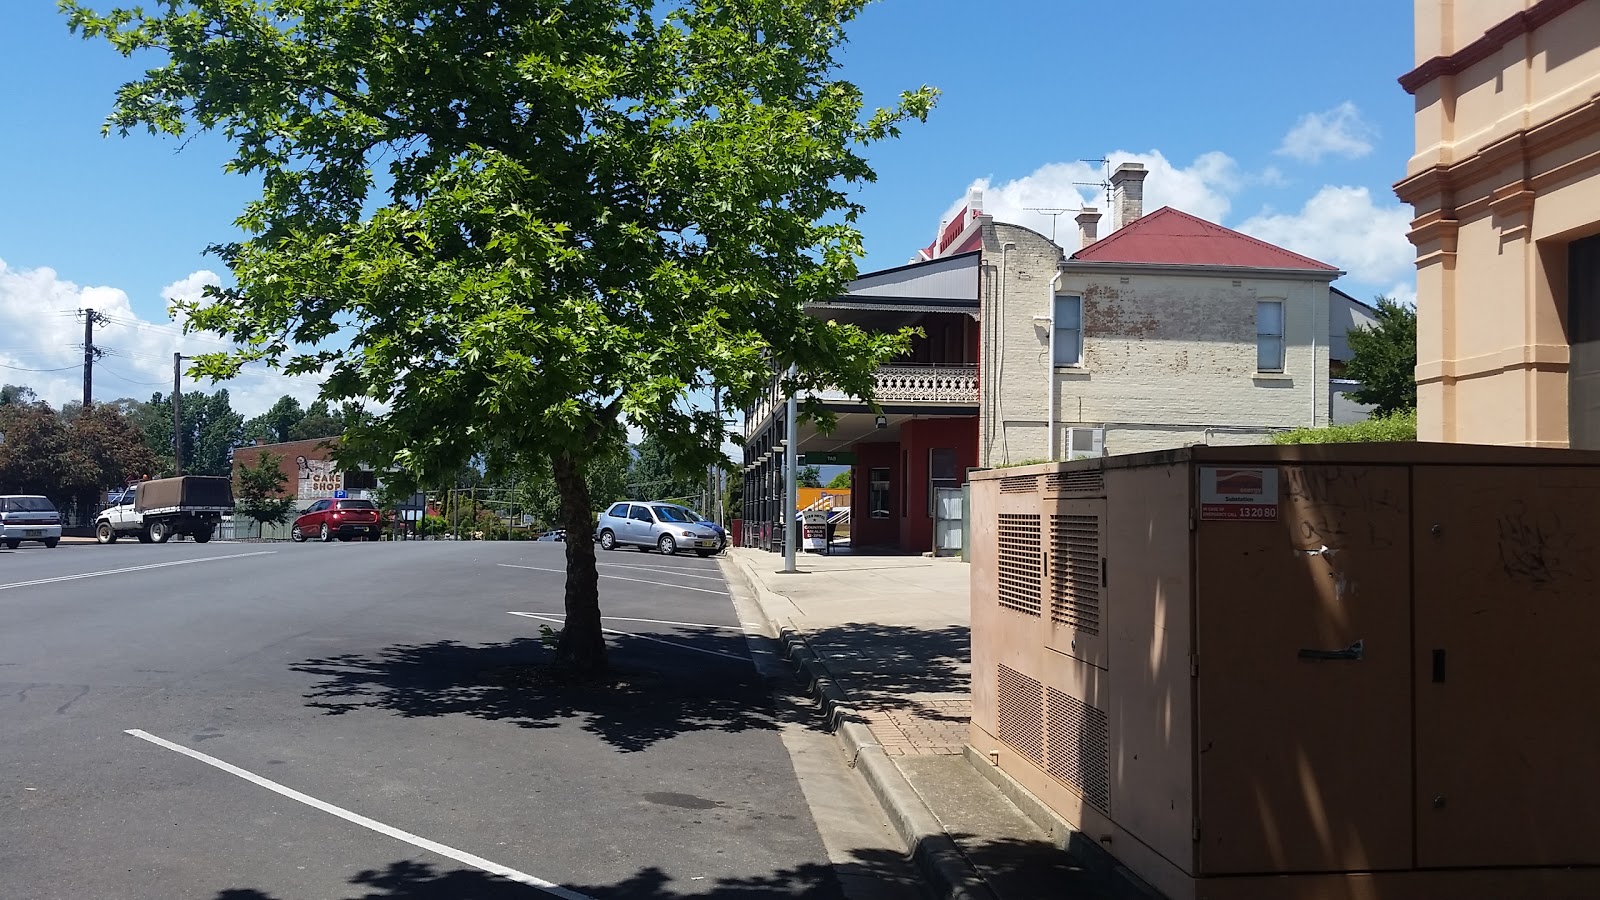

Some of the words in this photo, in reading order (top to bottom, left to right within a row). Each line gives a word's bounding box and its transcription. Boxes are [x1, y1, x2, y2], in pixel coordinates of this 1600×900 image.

[1240, 508, 1250, 517] 13
[1251, 508, 1263, 517] 20
[1264, 508, 1276, 517] 80
